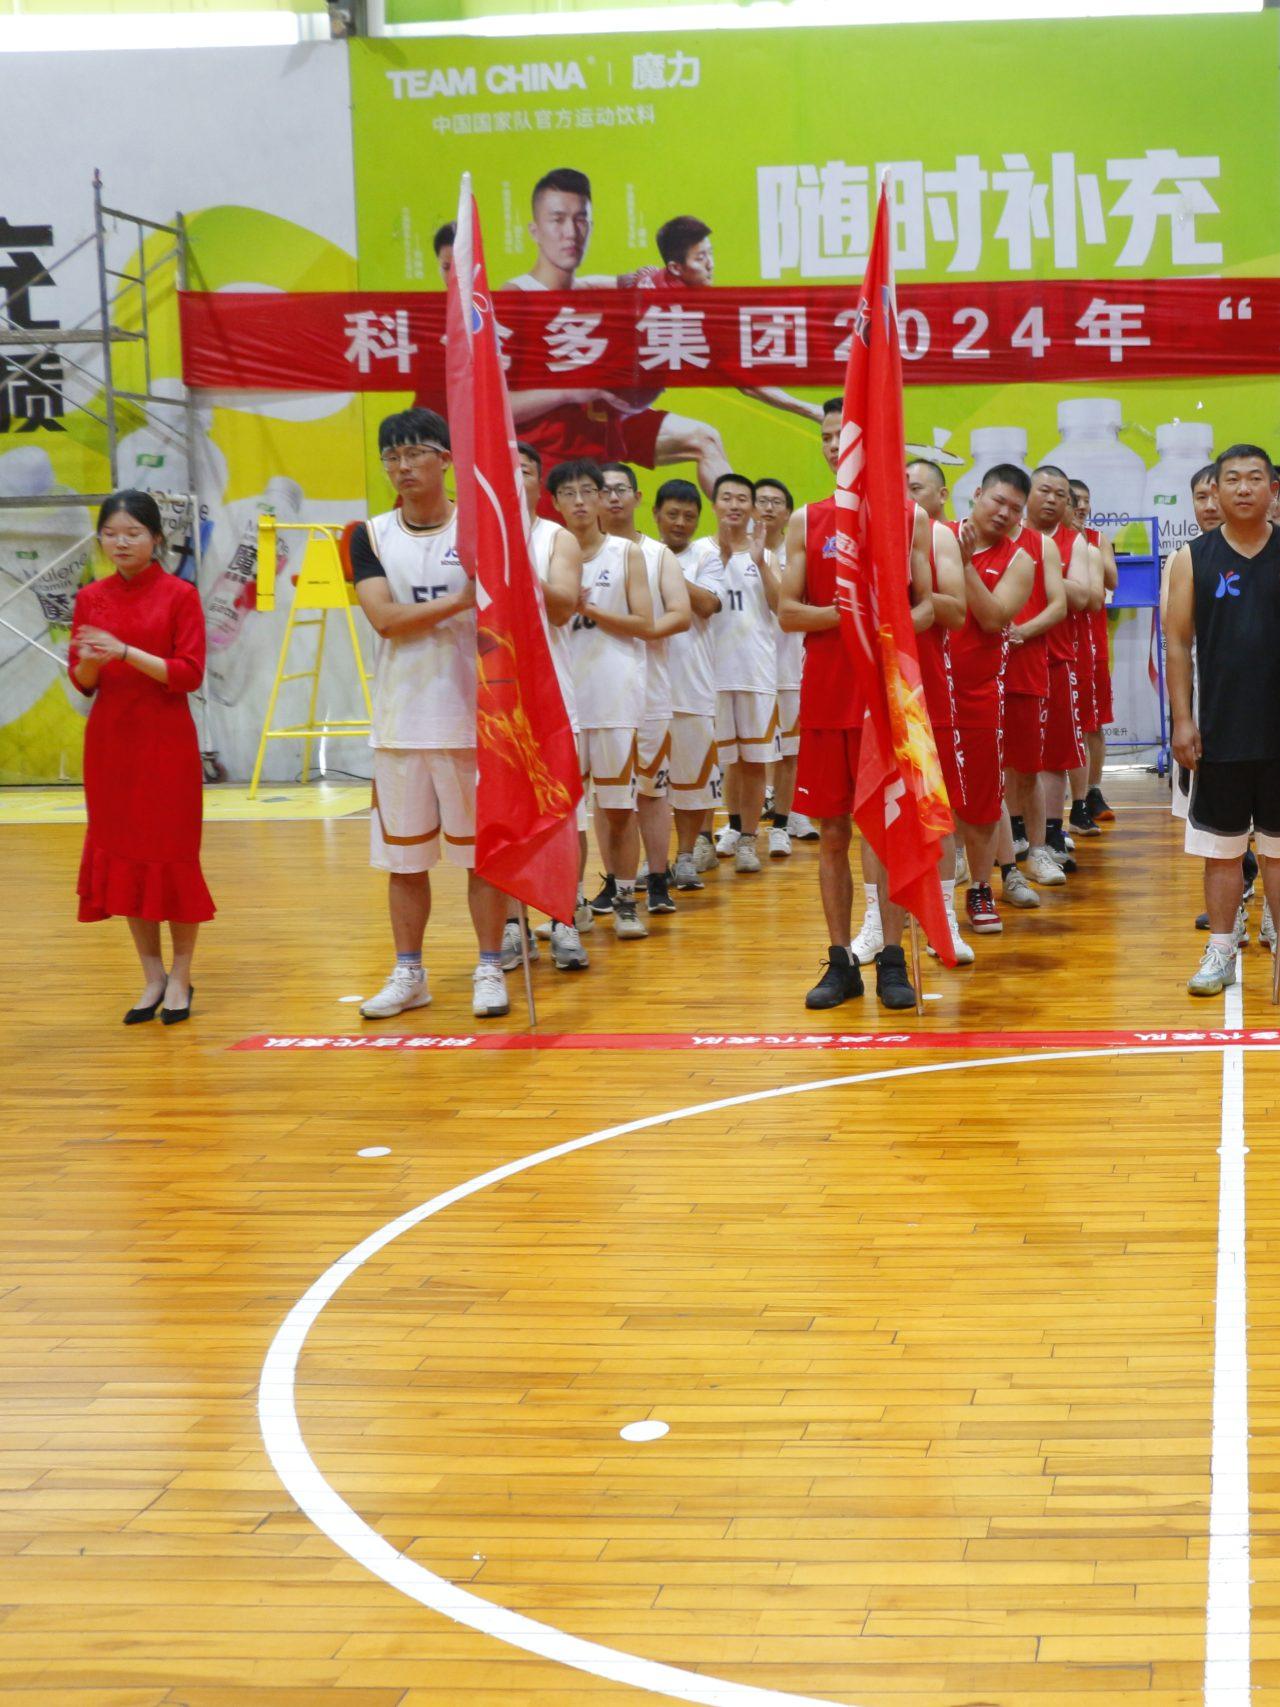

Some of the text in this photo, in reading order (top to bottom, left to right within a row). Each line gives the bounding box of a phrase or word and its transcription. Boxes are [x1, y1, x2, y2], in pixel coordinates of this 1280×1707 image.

[386, 51, 700, 99] TEAM CHINA 魔力
[432, 104, 656, 135] 中国国家队官方运动饮料
[757, 148, 1224, 280] 随时补充
[727, 589, 744, 611] 11
